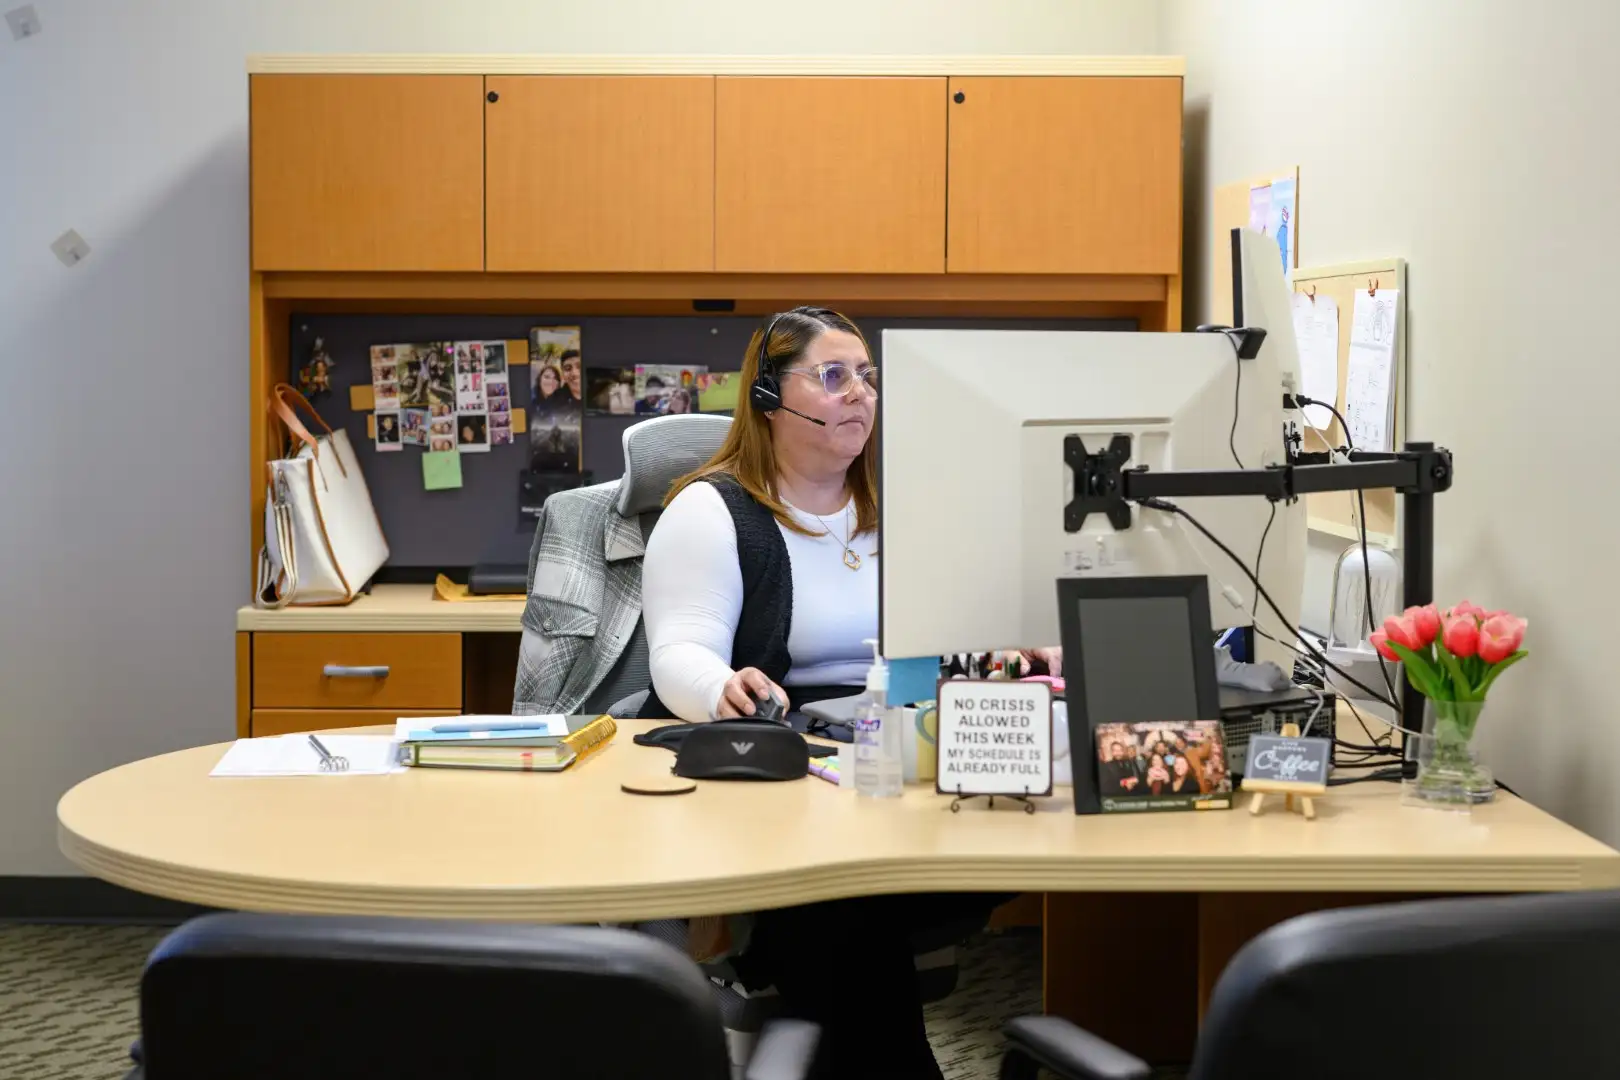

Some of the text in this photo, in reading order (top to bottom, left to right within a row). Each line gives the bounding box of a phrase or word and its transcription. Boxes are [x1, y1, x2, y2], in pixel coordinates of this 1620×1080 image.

[954, 698, 1035, 712] NO CRISIS
[959, 715, 1030, 728] ALLOWED
[954, 732, 1035, 745] THIS WEEK
[947, 748, 1041, 760] MY SCHEDULE IS
[947, 762, 1041, 775] ALREADY FULL
[1254, 749, 1319, 777] Coffee
